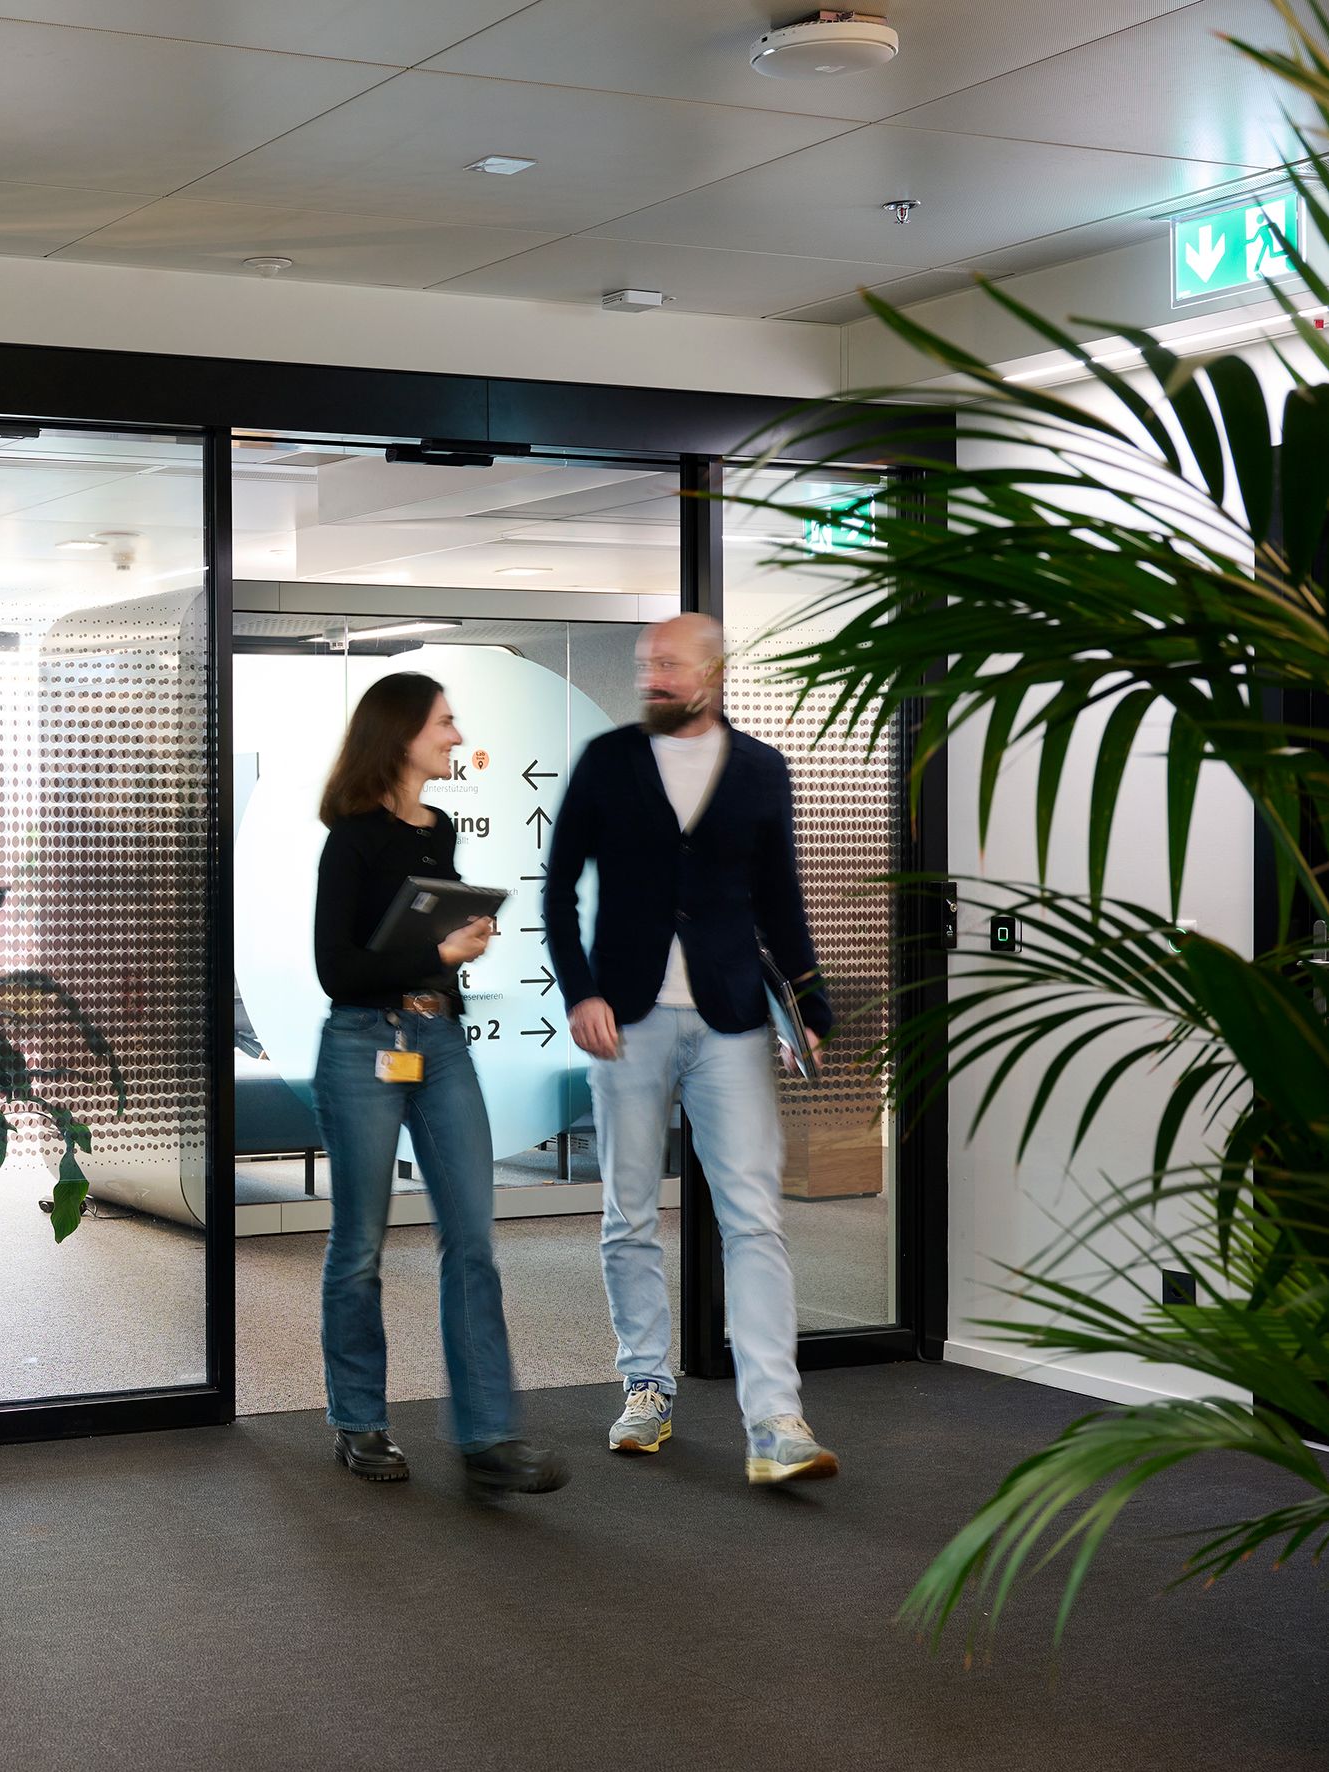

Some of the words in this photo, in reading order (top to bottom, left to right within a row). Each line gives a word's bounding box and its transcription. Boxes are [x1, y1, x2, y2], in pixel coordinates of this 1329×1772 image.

[422, 784, 478, 794] Unterstützung
[449, 811, 489, 838] ing
[462, 991, 504, 1001] eservieren
[487, 1019, 500, 1040] 2
